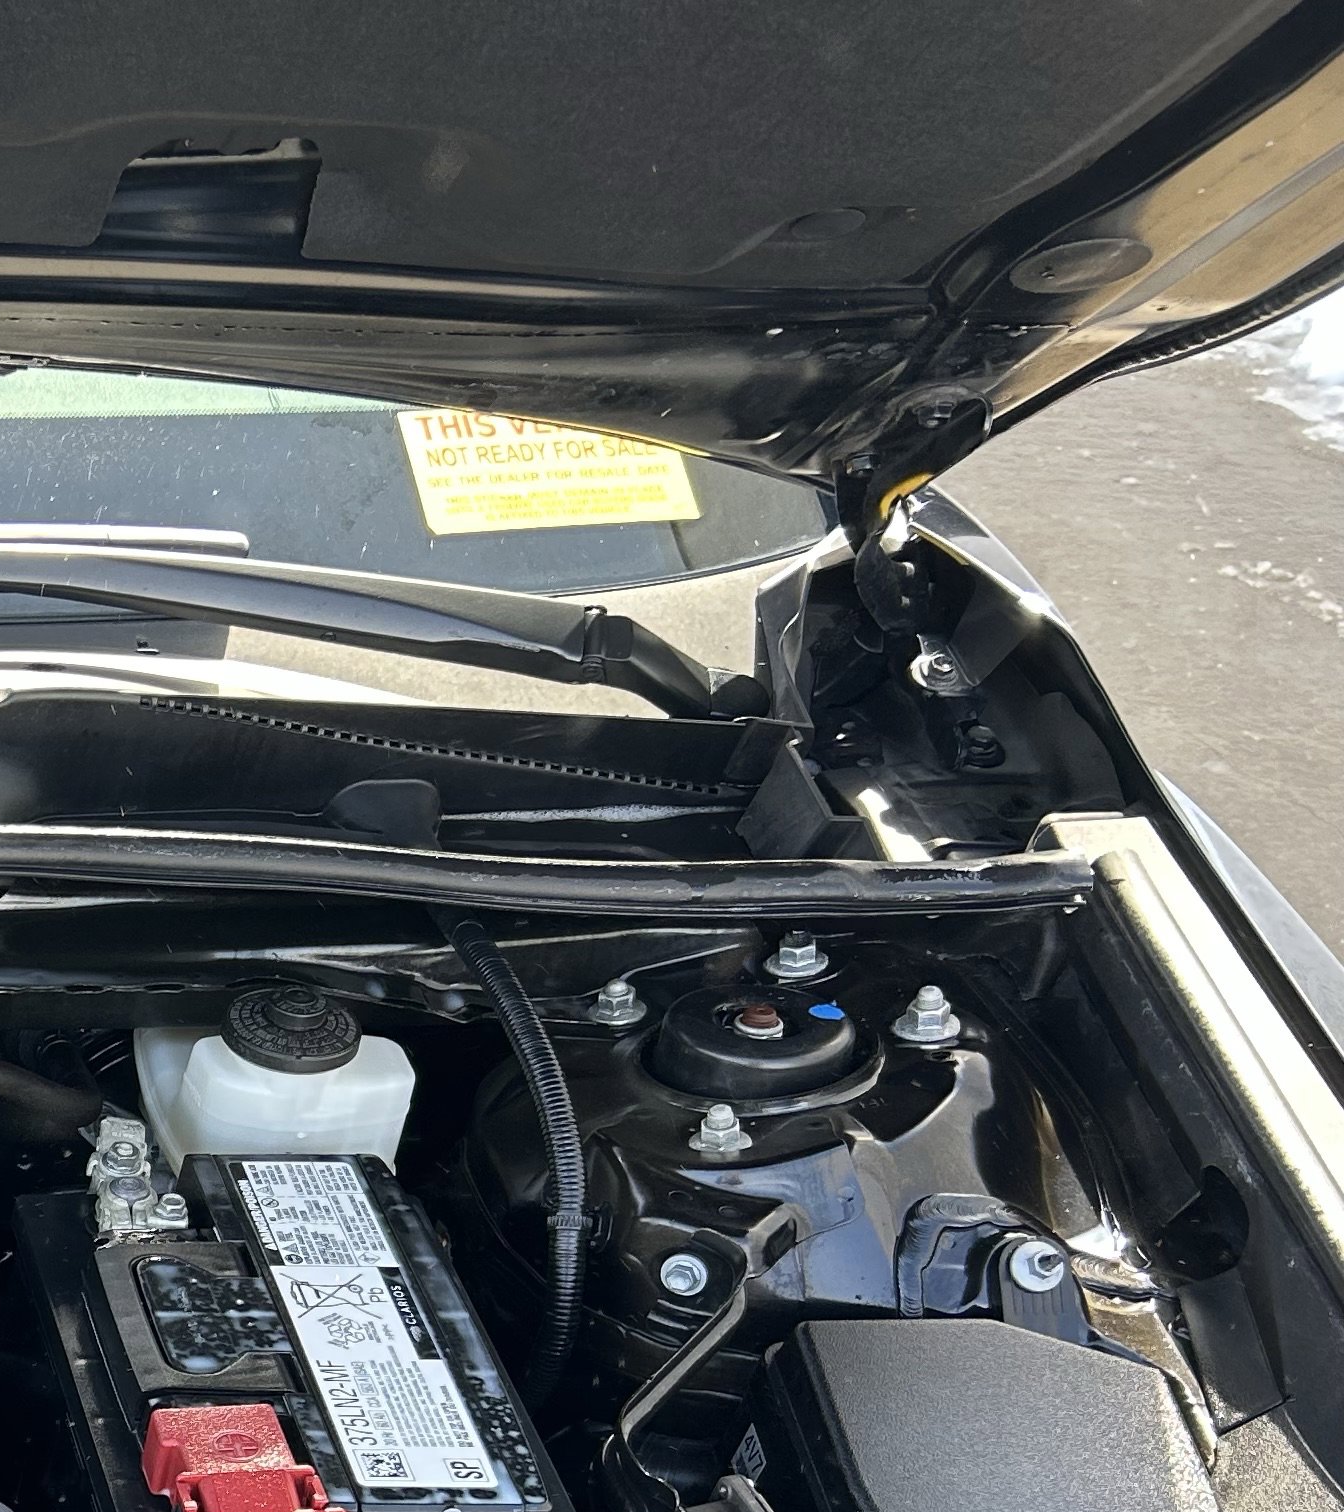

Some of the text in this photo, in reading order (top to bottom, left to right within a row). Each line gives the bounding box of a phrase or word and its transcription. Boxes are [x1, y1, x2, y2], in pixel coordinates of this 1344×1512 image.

[414, 412, 496, 441] THIS
[426, 446, 474, 469] NOT
[477, 442, 546, 465] READY
[553, 440, 597, 460] FOR
[237, 1179, 276, 1243] DANGER/POISON
[368, 1286, 387, 1304] Pb
[390, 1284, 419, 1326] CLARIOS
[315, 1359, 379, 1447] 375LN2-MF
[454, 1460, 485, 1481] SP
[744, 1434, 763, 1473] 4V7
